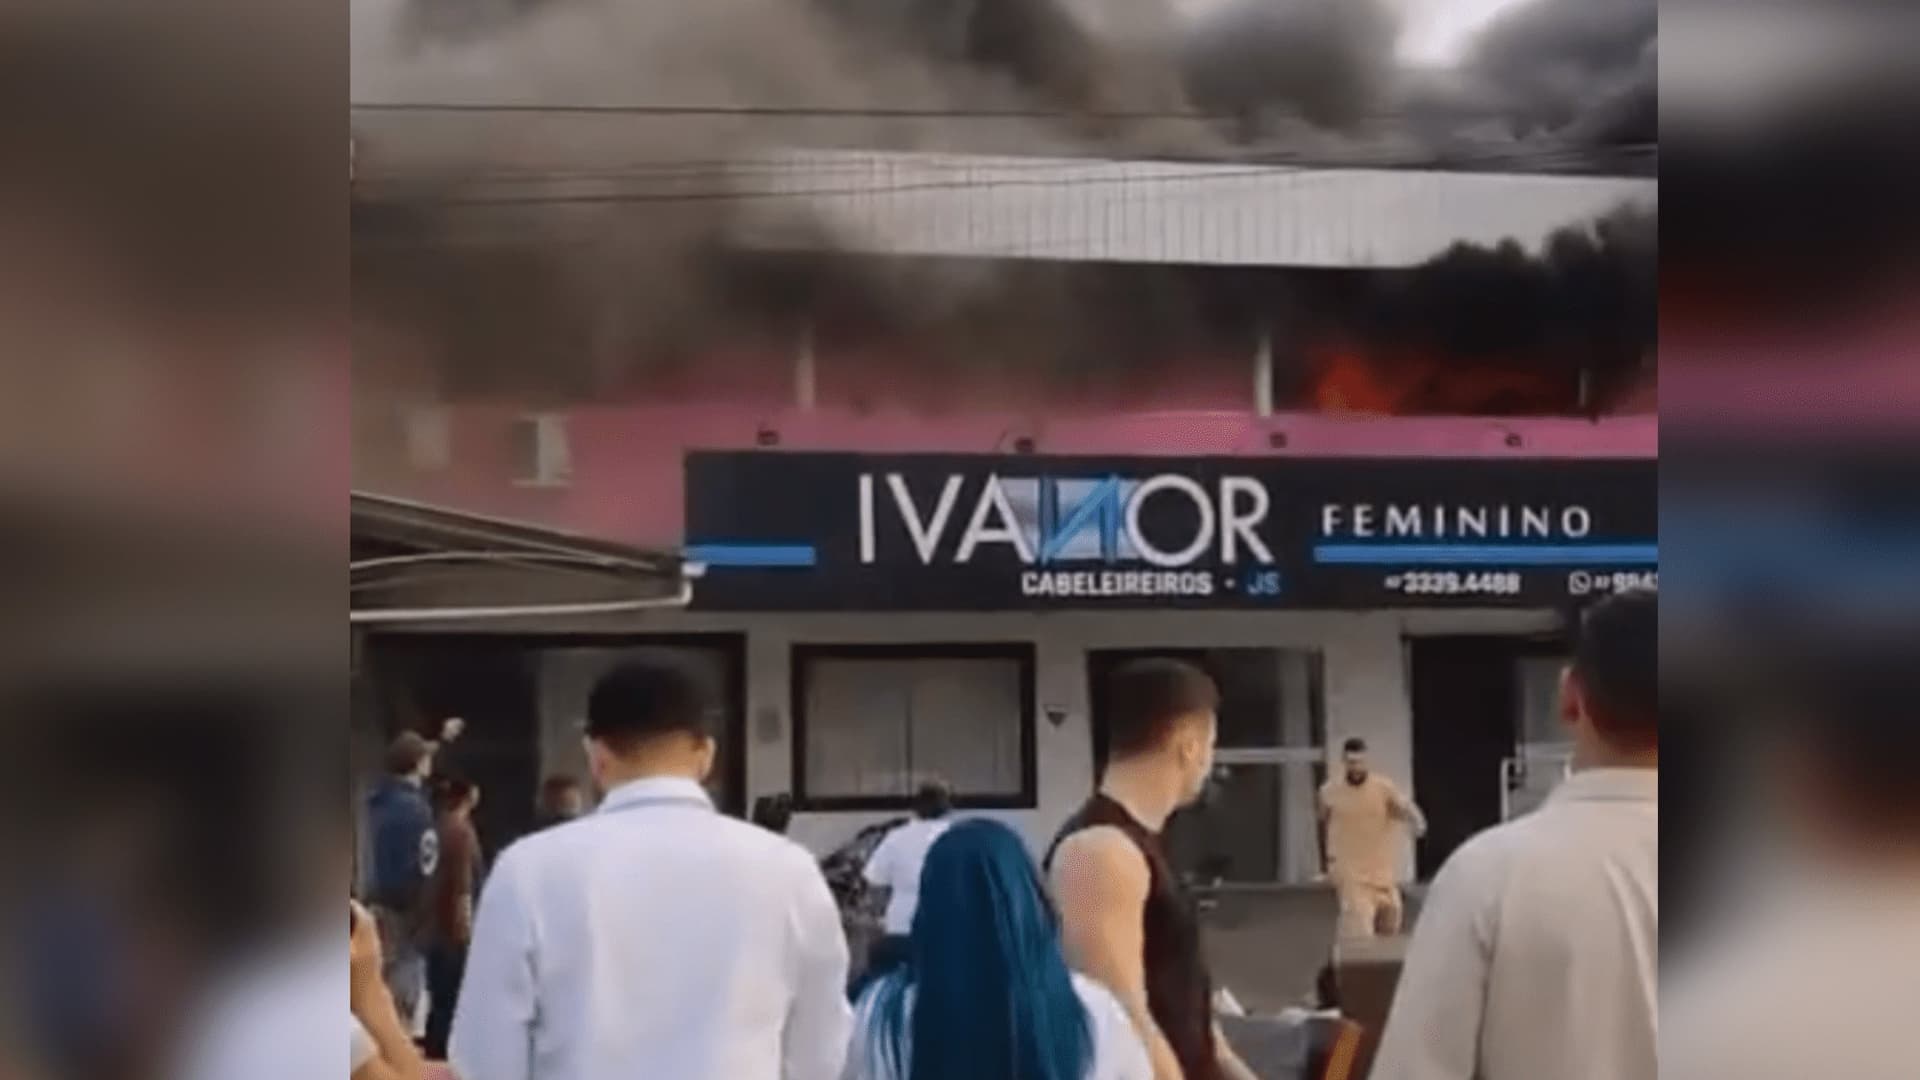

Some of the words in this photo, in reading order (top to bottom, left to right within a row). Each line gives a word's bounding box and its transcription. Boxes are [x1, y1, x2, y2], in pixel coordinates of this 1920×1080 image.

[859, 474, 1274, 566] IVANOR
[1321, 504, 1591, 538] FEMININO
[1022, 571, 1213, 595] CABELEIREIROS
